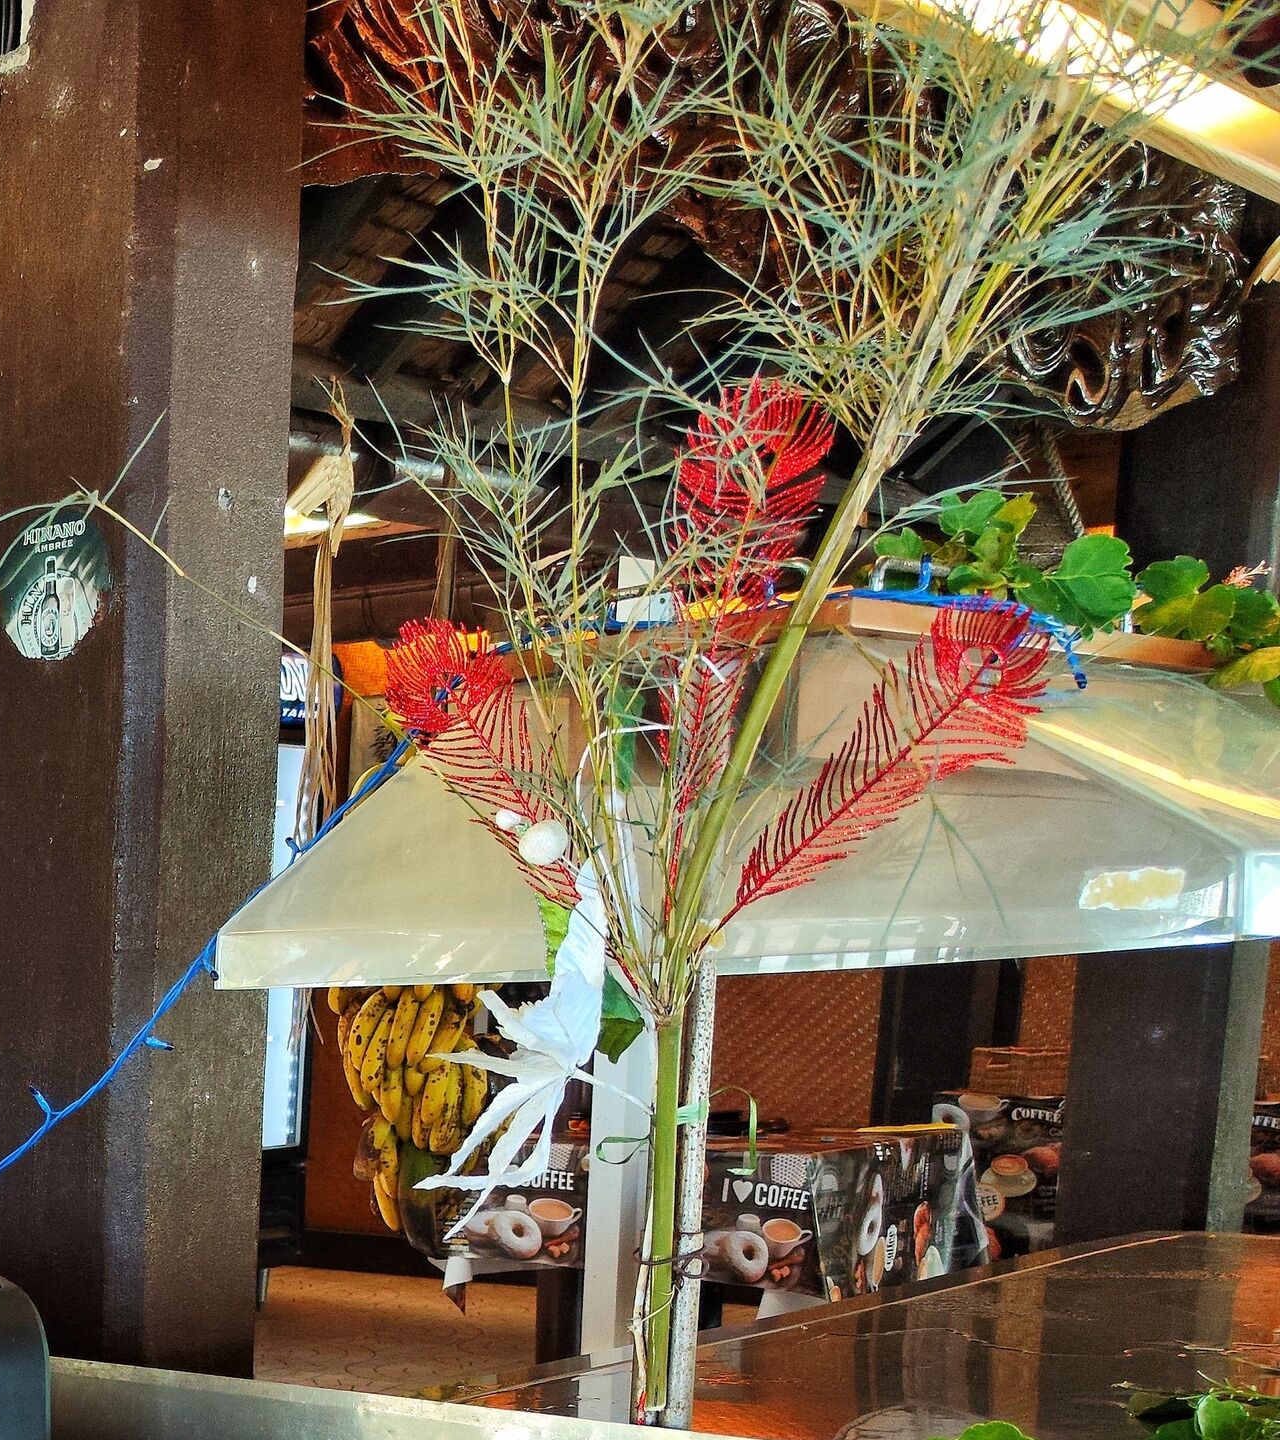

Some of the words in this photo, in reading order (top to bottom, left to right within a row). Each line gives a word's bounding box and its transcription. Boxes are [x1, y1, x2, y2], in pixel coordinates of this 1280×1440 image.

[23, 520, 85, 545] HINANO
[1011, 1107, 1061, 1123] COFFEE
[722, 1178, 729, 1202] I
[754, 1182, 810, 1210] COFFEE
